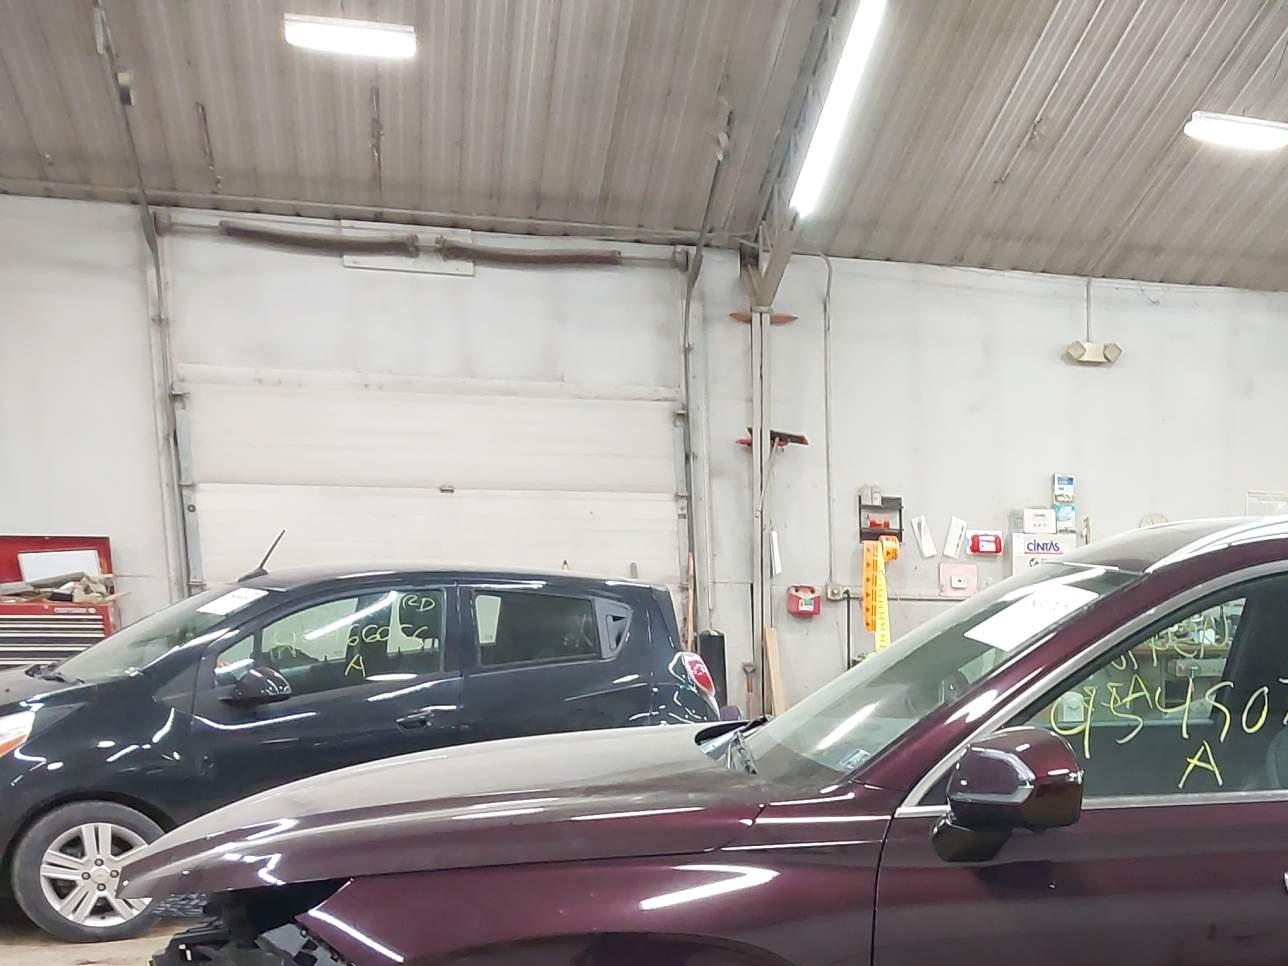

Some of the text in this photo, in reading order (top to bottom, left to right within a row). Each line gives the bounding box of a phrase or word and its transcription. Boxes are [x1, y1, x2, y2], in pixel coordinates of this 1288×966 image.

[1026, 539, 1060, 552] CINTAS
[402, 594, 436, 612] RD
[344, 654, 367, 678] A
[1177, 739, 1224, 789] A
